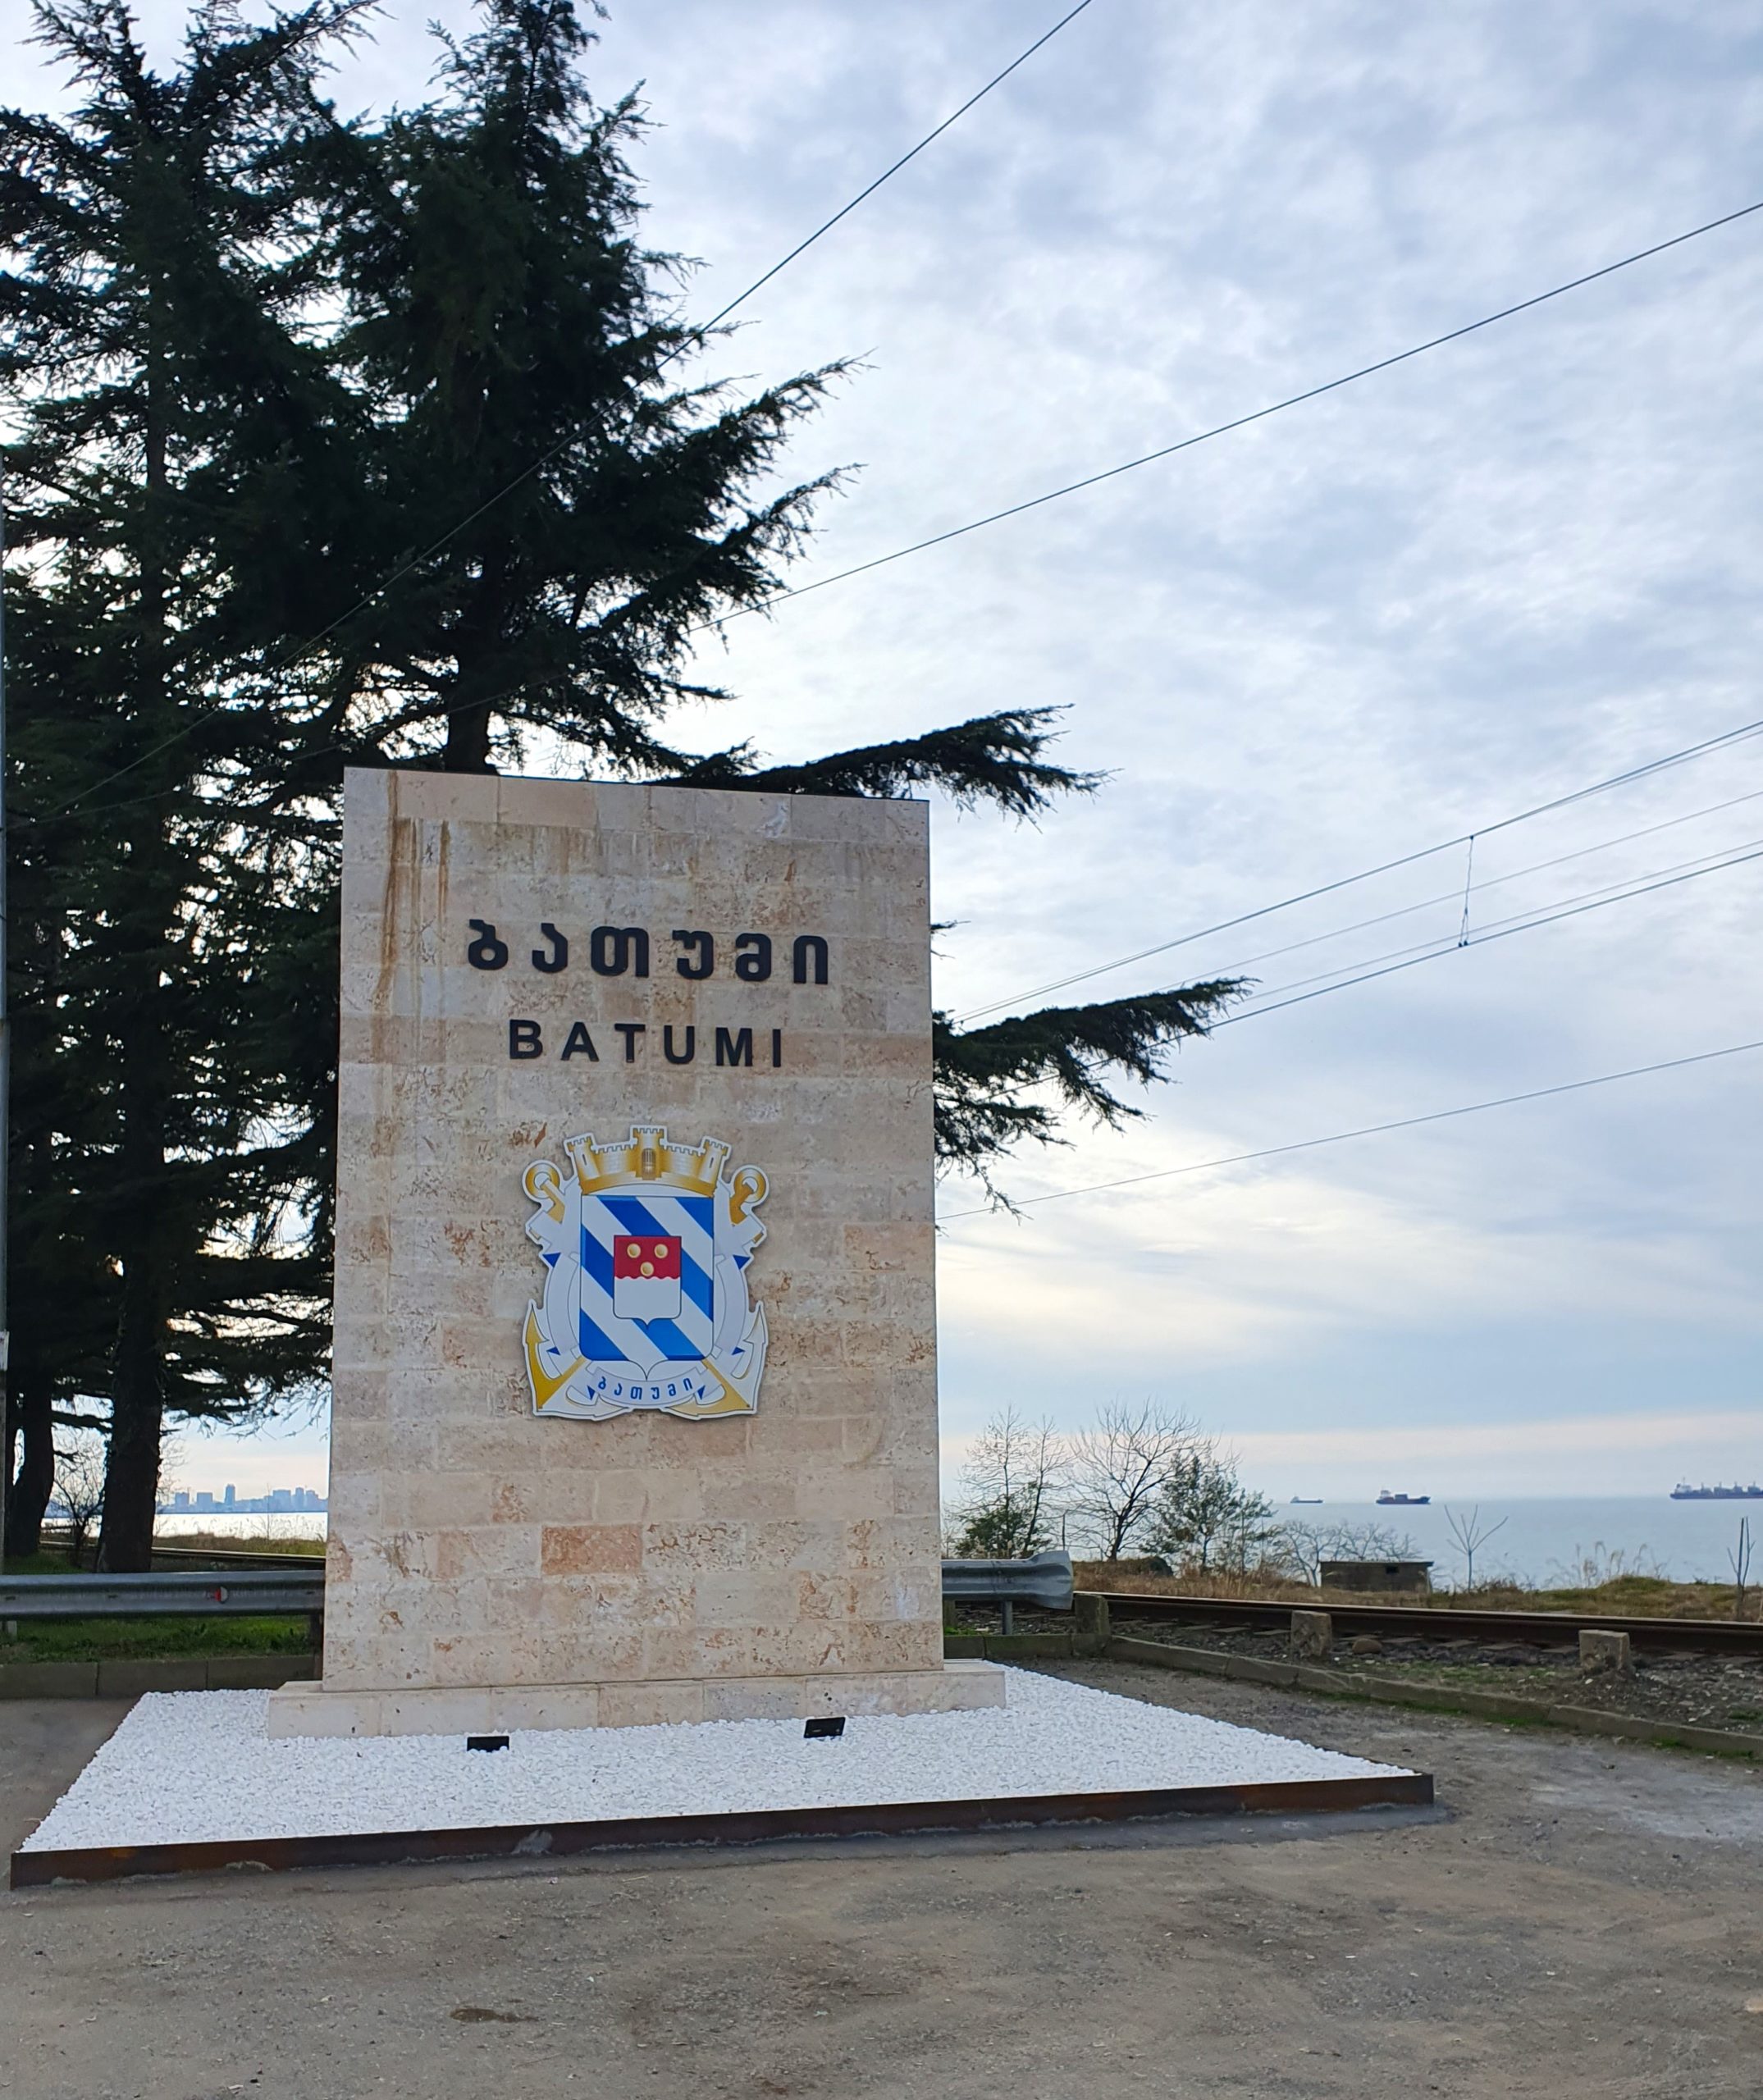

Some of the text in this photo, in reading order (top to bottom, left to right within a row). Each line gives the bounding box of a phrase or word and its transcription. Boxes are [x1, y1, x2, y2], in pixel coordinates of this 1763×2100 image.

[468, 918, 829, 985] ბათუმი
[509, 1019, 782, 1067] BATUMI
[597, 1376, 693, 1400] ბათუმი
